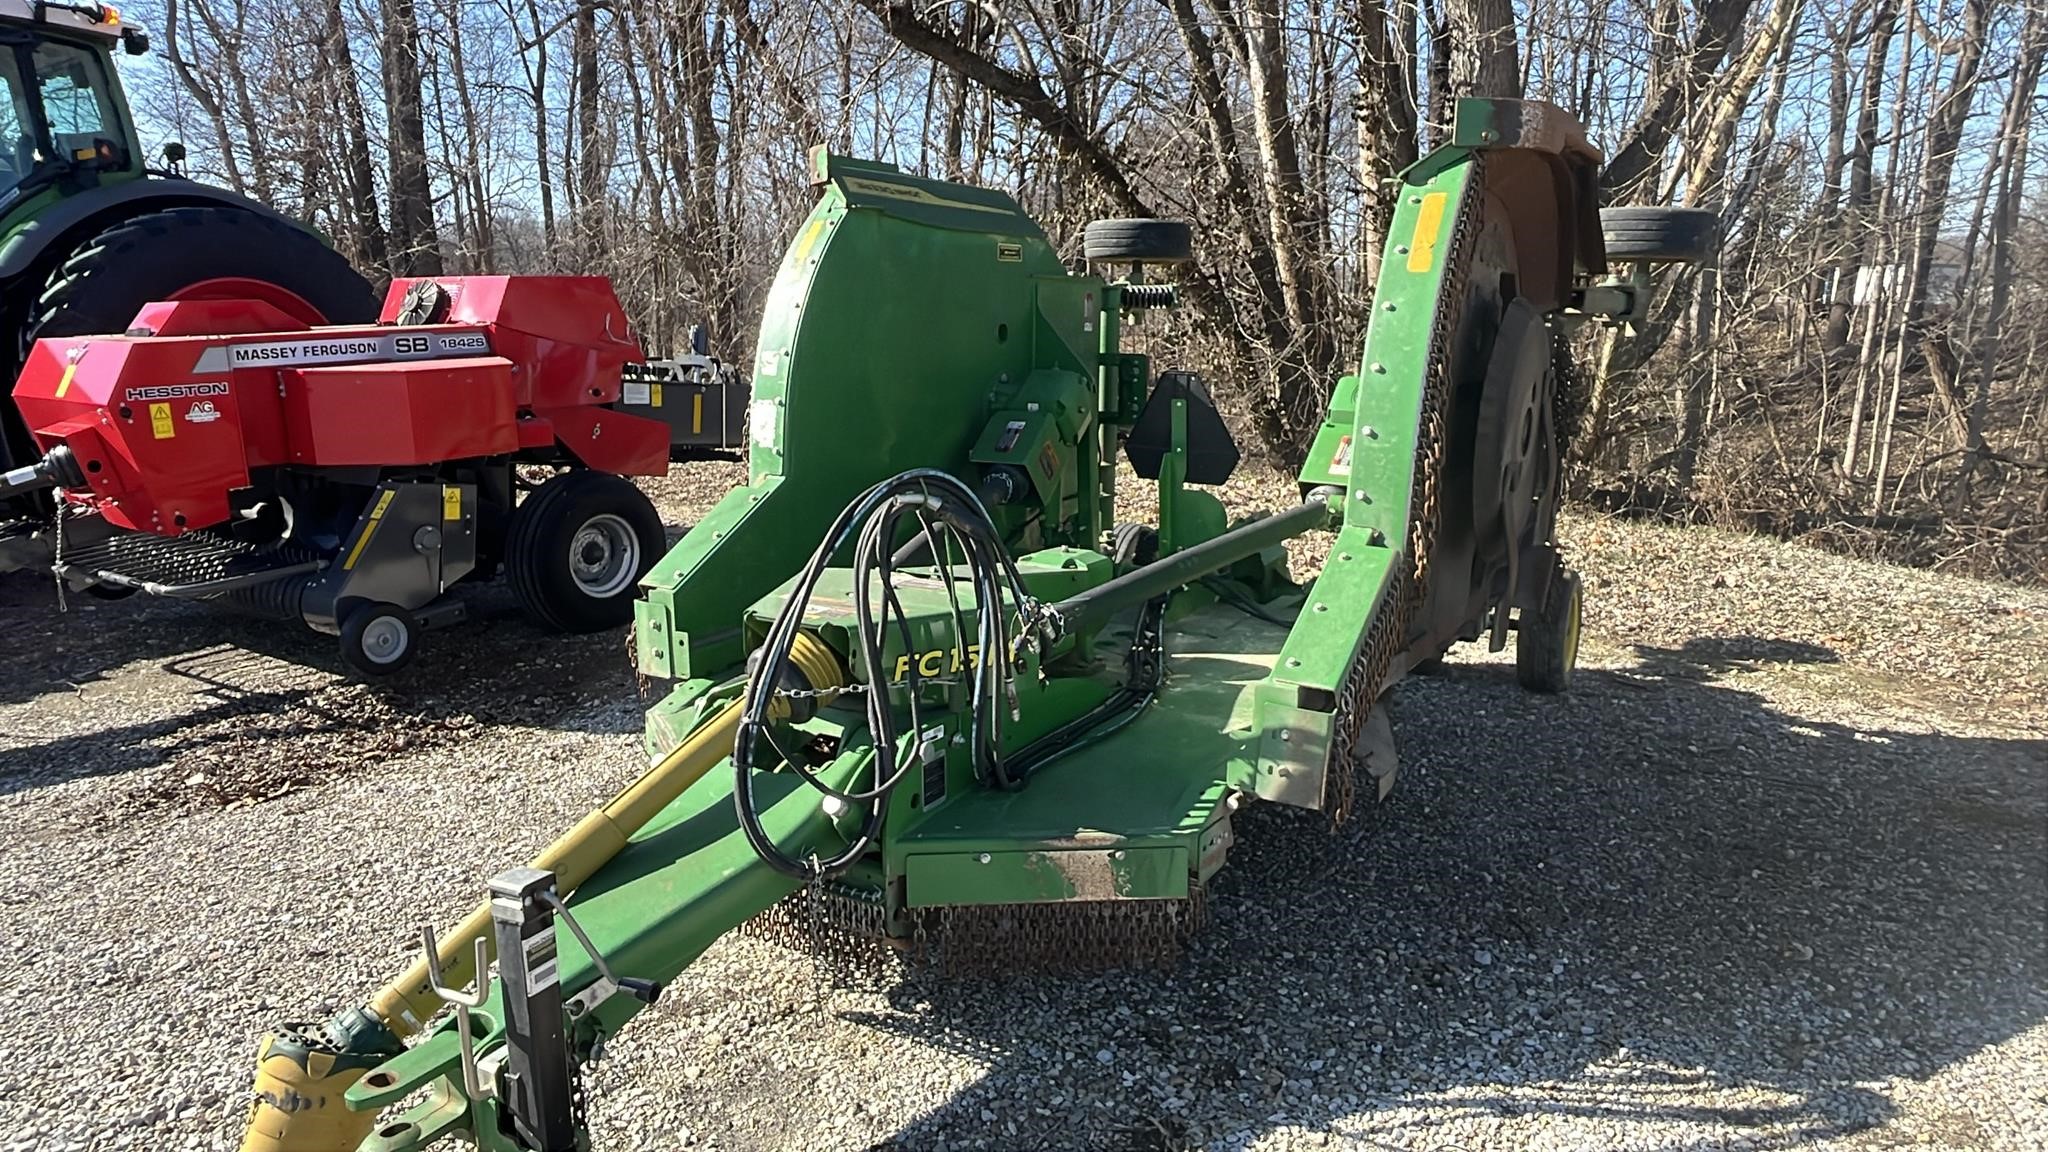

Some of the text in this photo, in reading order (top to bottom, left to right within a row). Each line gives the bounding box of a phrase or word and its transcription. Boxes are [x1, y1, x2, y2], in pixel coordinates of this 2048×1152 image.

[235, 337, 485, 361] MASSEY FERGUSON SB 1842S
[126, 382, 229, 401] HESSTON
